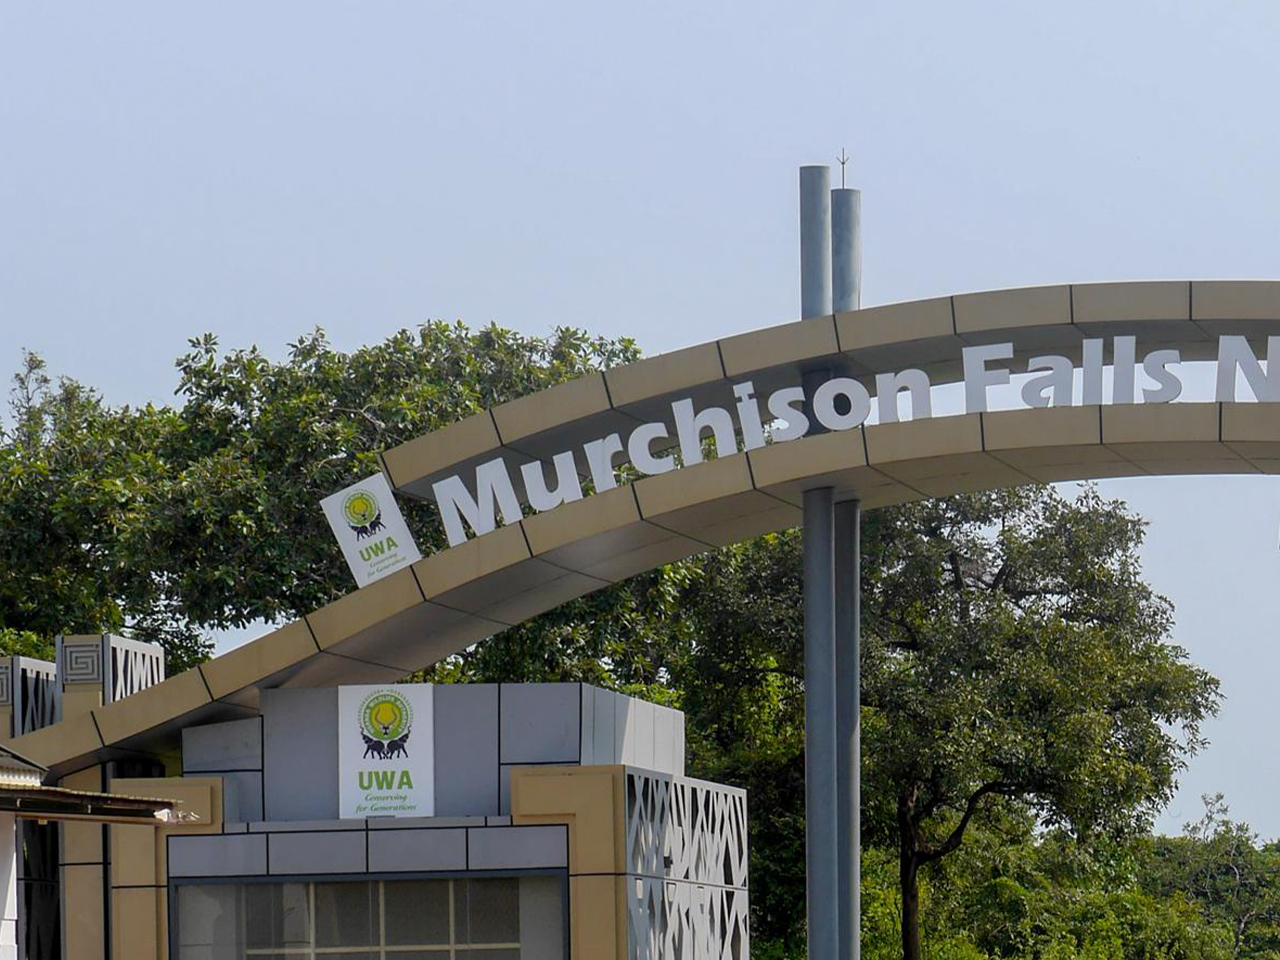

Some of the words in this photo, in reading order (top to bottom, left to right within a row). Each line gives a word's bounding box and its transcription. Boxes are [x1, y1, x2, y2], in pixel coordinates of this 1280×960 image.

[432, 367, 933, 547] Murchison
[962, 335, 1182, 413] Falls
[359, 536, 398, 562] UWA
[358, 770, 413, 790] UWA
[365, 793, 408, 803] Conserving
[355, 803, 369, 814] for
[370, 803, 417, 812] Generations
